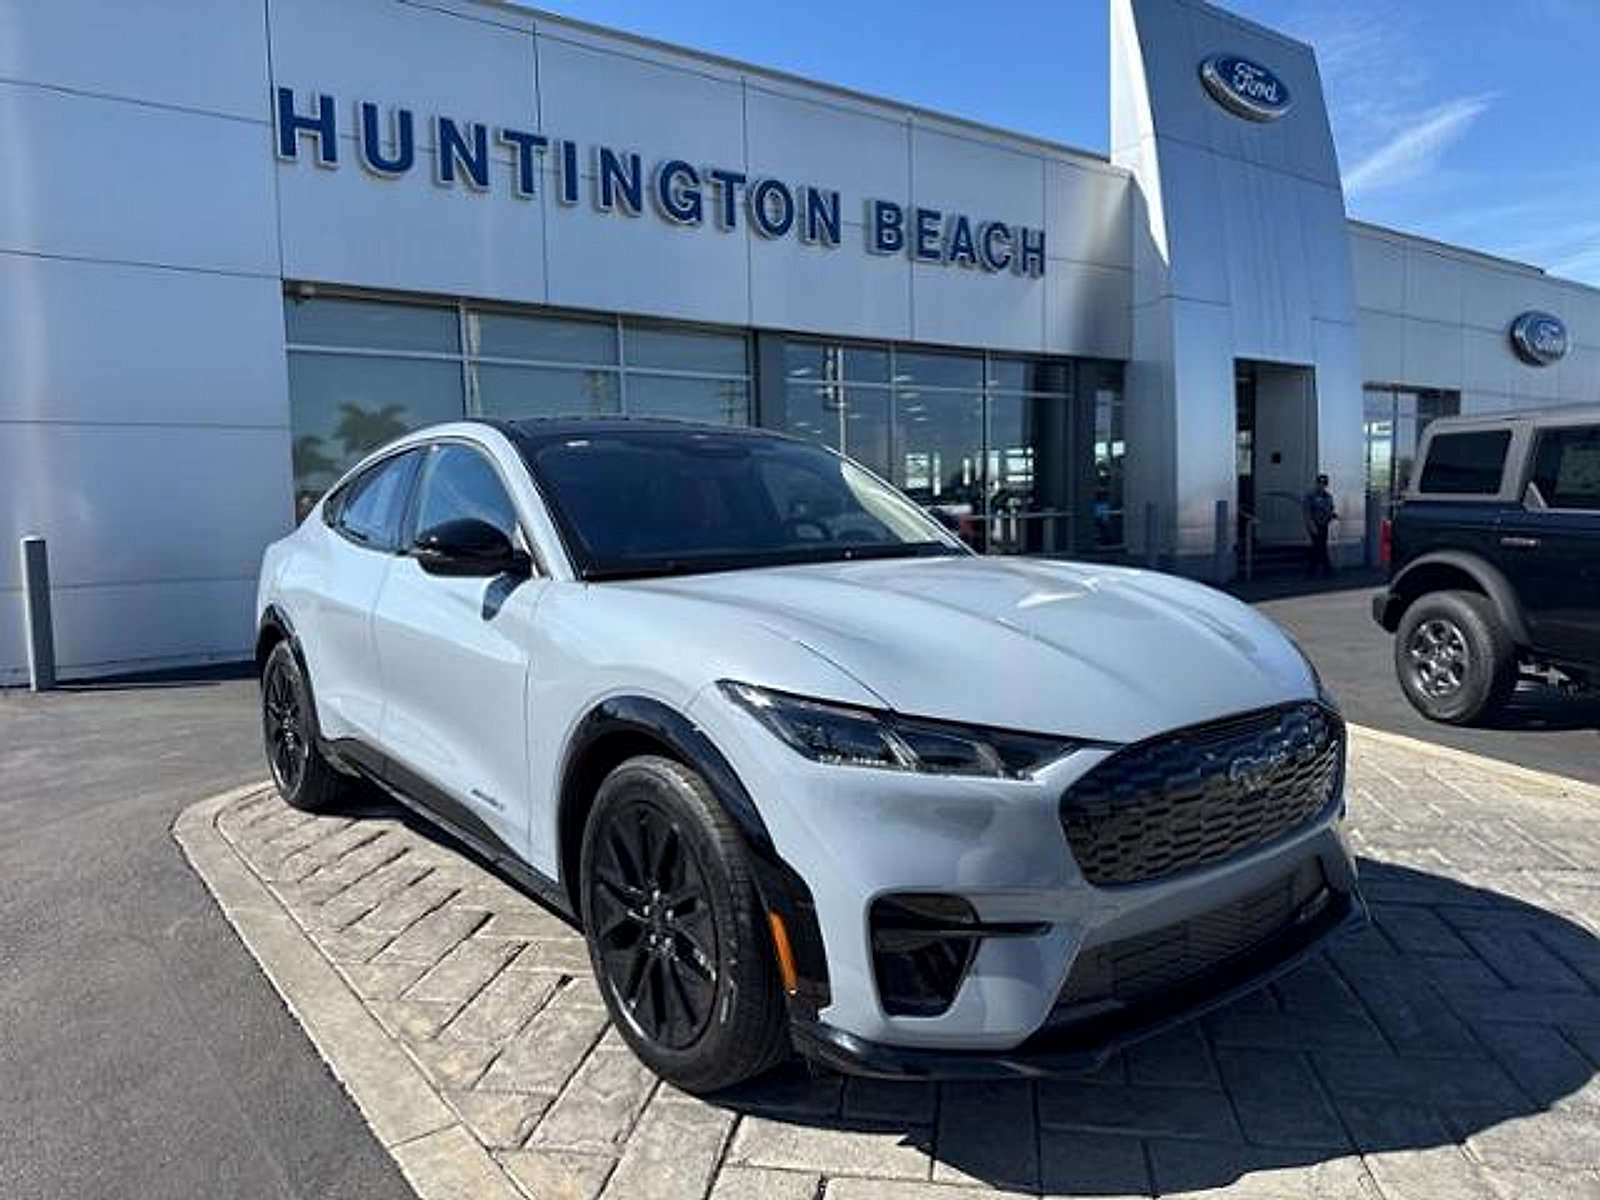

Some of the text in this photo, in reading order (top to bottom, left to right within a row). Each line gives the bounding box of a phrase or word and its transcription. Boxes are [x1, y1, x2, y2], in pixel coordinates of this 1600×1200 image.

[1233, 62, 1280, 102] Ford
[276, 86, 1047, 277] HUNTINGTON BEACH
